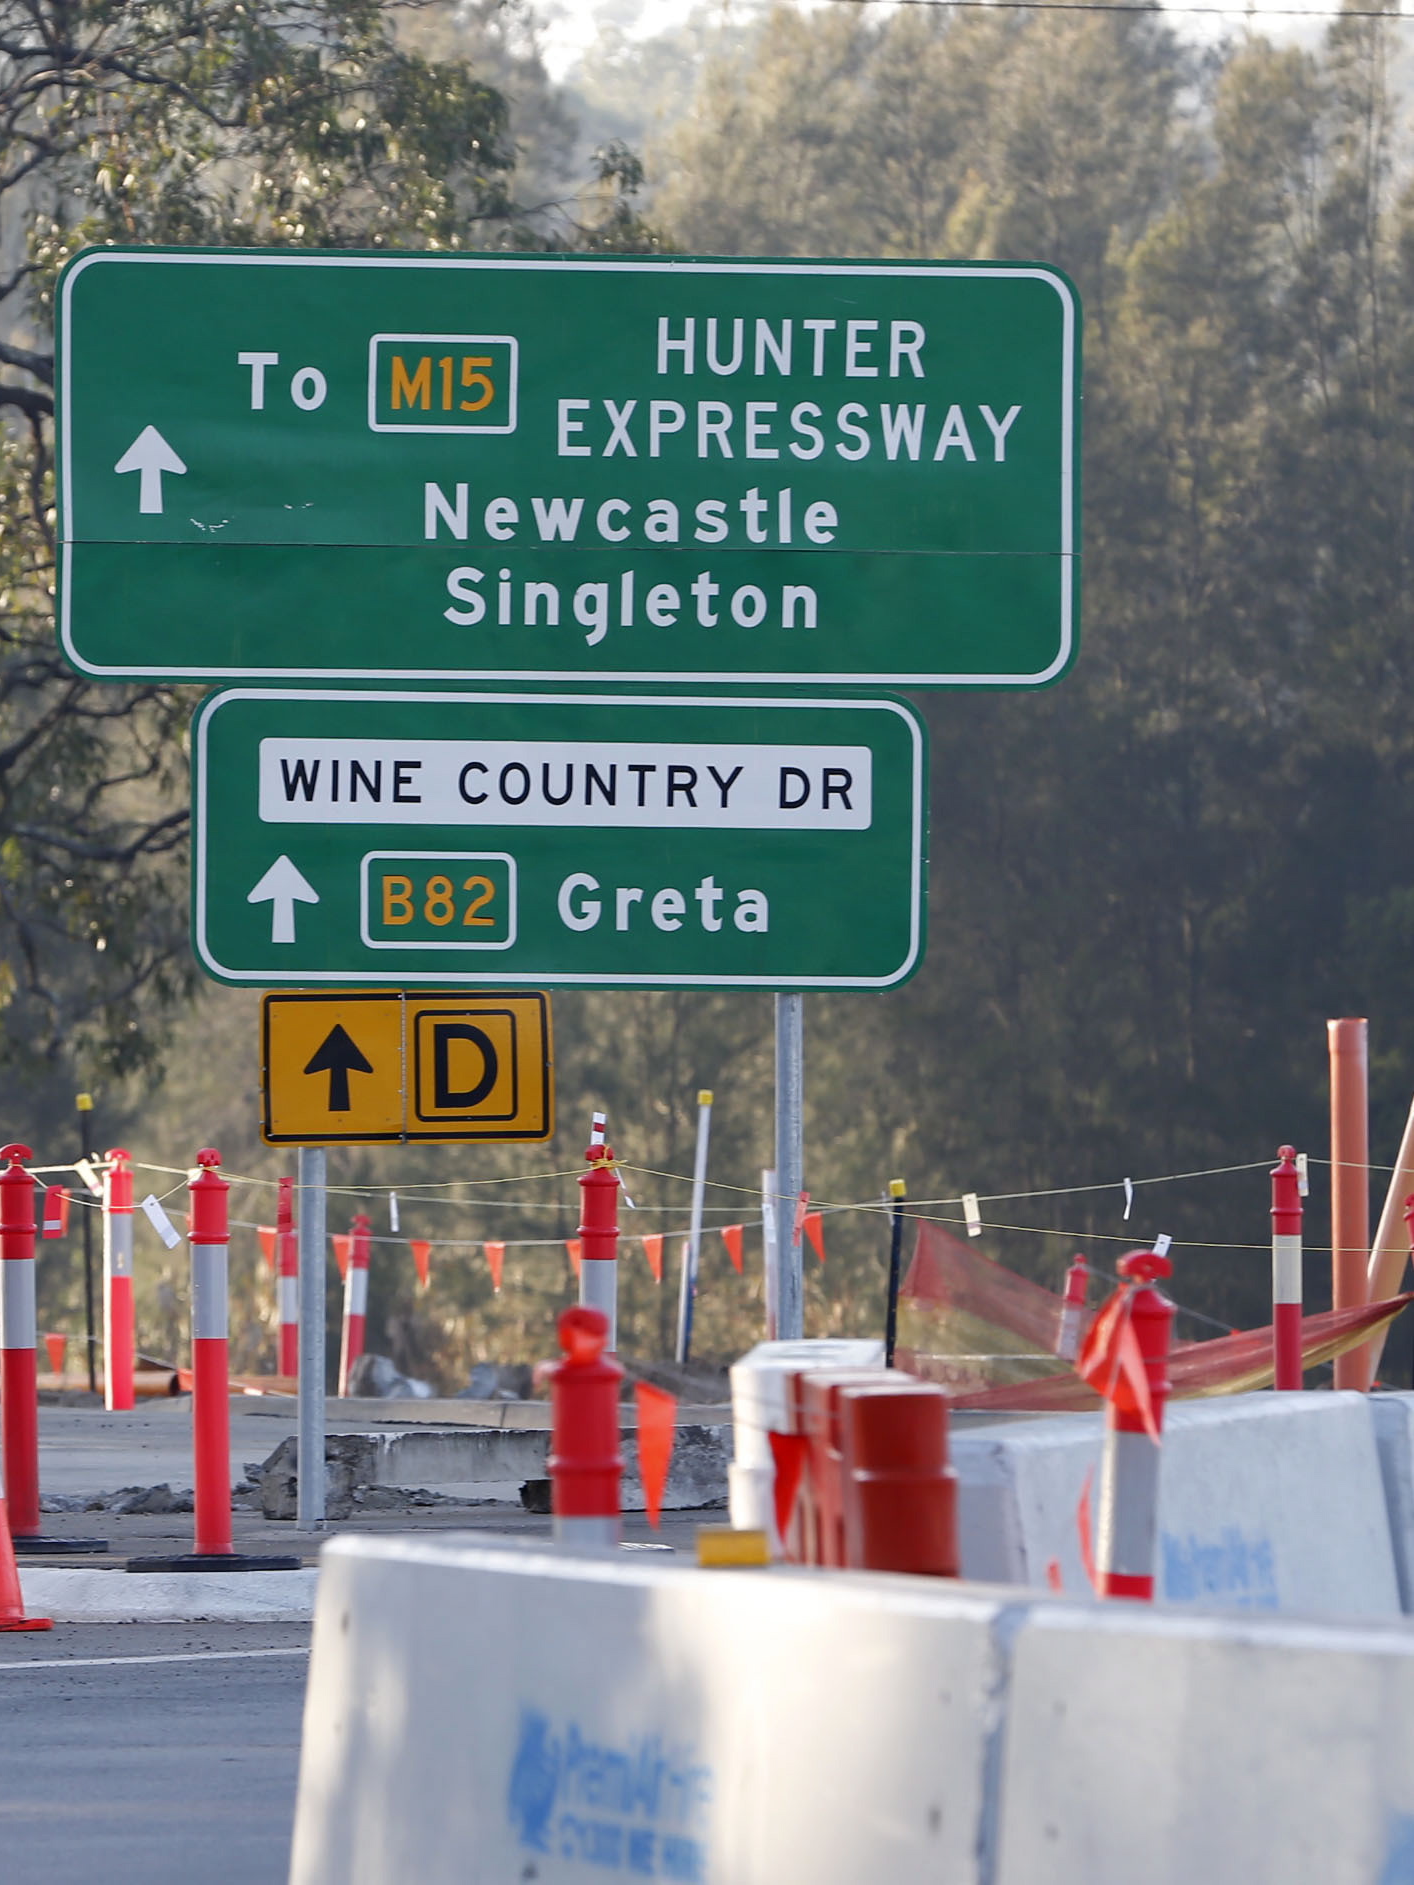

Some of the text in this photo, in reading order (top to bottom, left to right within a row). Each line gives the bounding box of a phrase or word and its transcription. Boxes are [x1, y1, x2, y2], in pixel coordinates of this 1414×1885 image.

[657, 317, 926, 378] HUNTER
[238, 352, 495, 412] To M15
[558, 398, 1022, 462] EXPRESSWAY
[424, 482, 838, 544] Newcastle
[443, 566, 817, 647] Singleton
[280, 758, 853, 810] WINE COUNTRY DR
[381, 872, 769, 933] B82 Greta
[434, 1023, 499, 1109] D
